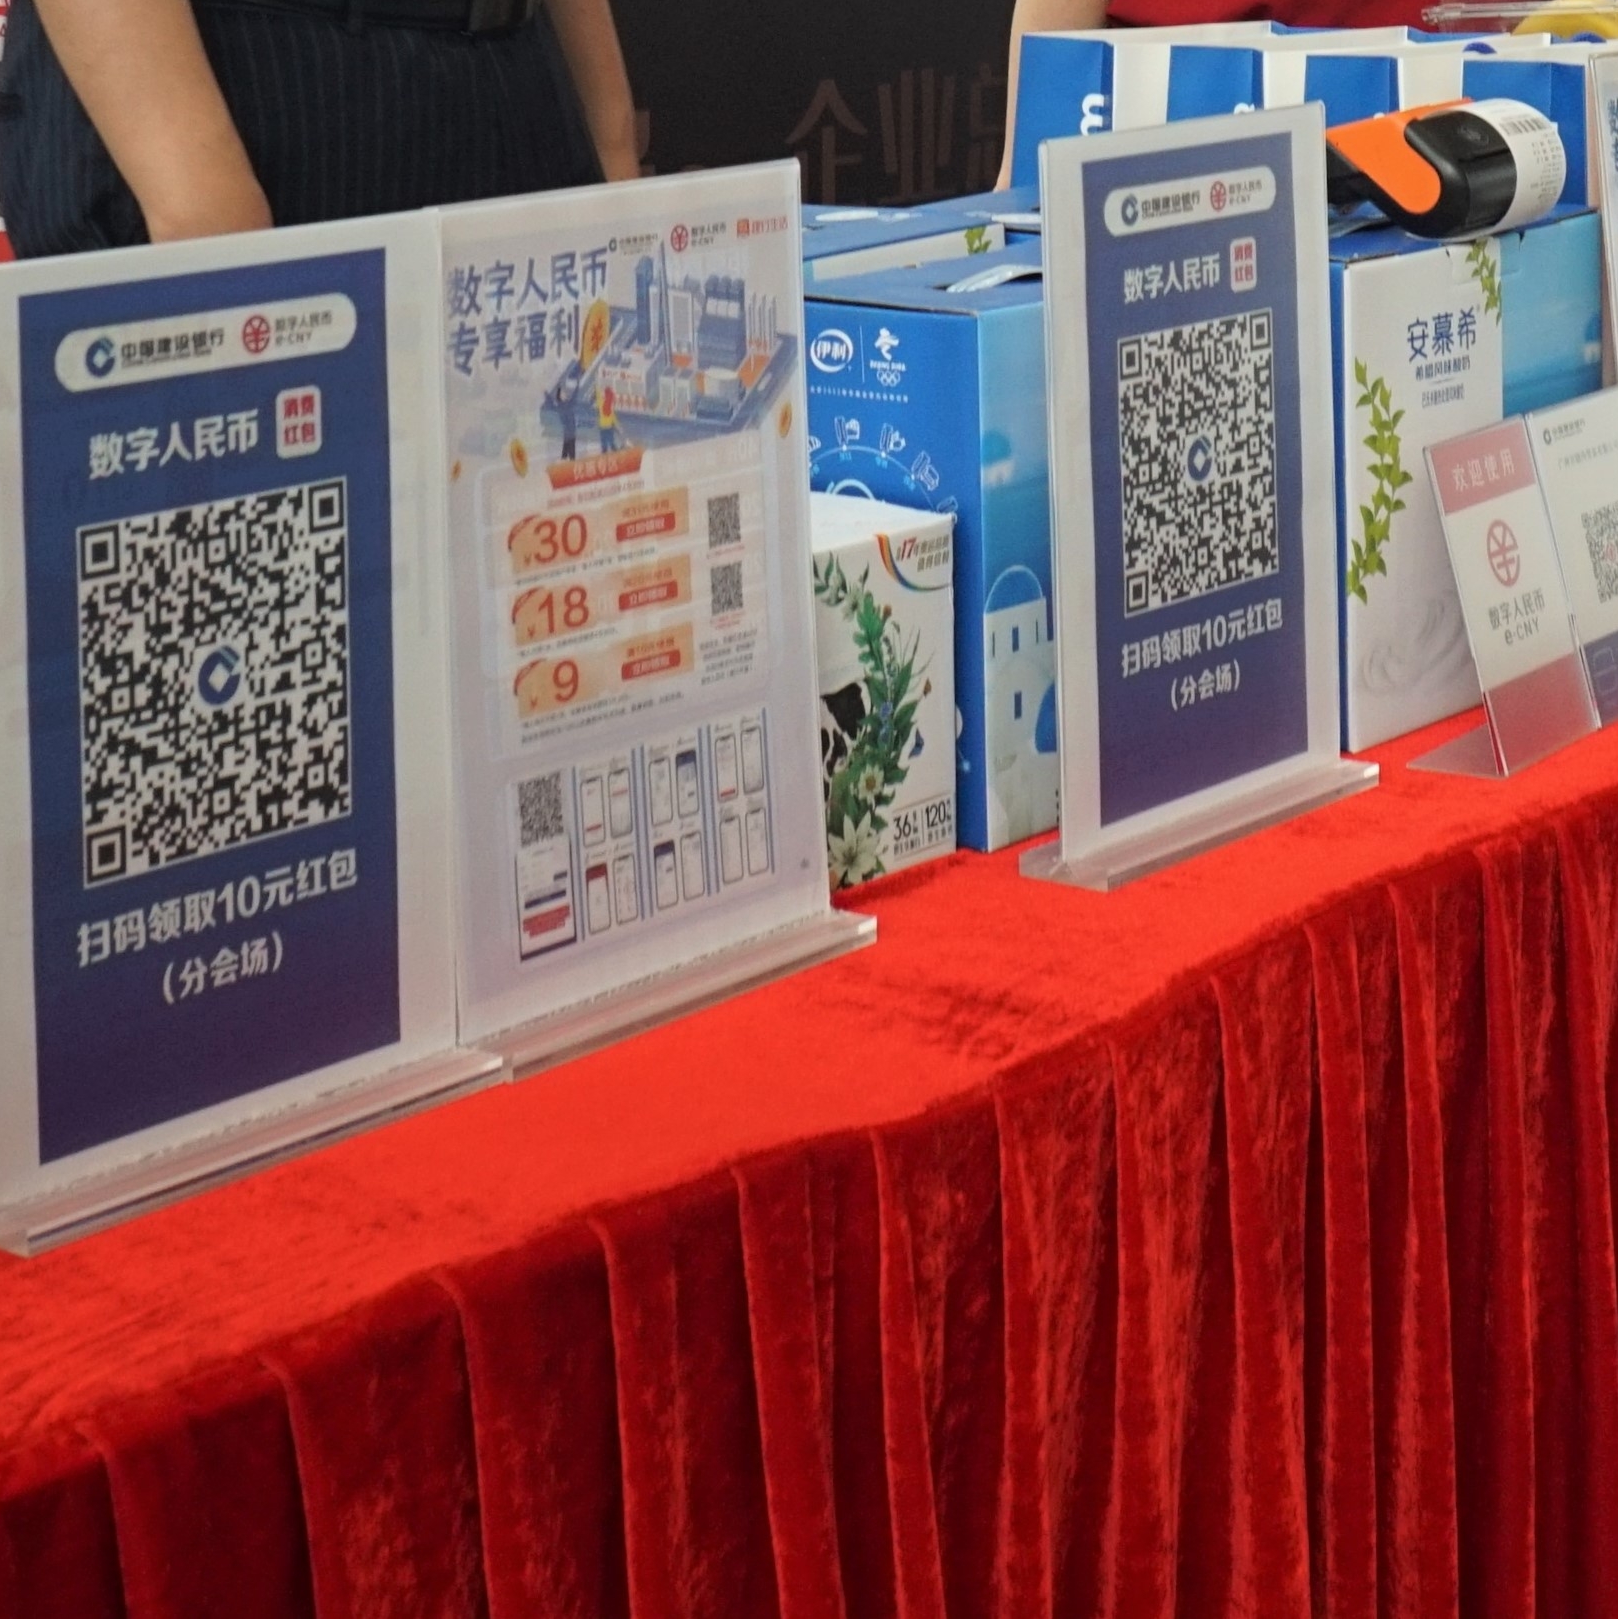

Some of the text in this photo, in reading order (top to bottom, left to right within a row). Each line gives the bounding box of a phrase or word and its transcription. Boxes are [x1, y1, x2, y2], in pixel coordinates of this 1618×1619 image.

[1141, 189, 1201, 214] 中国建设银行
[447, 244, 609, 320] 数字人民币
[1123, 253, 1222, 305] 数字人民币
[1234, 263, 1255, 283] 红包
[120, 327, 225, 360] 中国建设银行
[274, 311, 334, 334] 数字人民币
[447, 304, 581, 377] 专享福利
[1406, 306, 1477, 363] 安慕希
[283, 392, 316, 419] 消费
[88, 408, 259, 481] 数字人民币
[283, 420, 317, 447] 红包
[1452, 447, 1516, 492] 欢迎使用
[1488, 590, 1546, 632] 数字人民币
[1121, 598, 1283, 679] 扫码领取10元红包
[76, 848, 359, 969] 扫码领取10元红包
